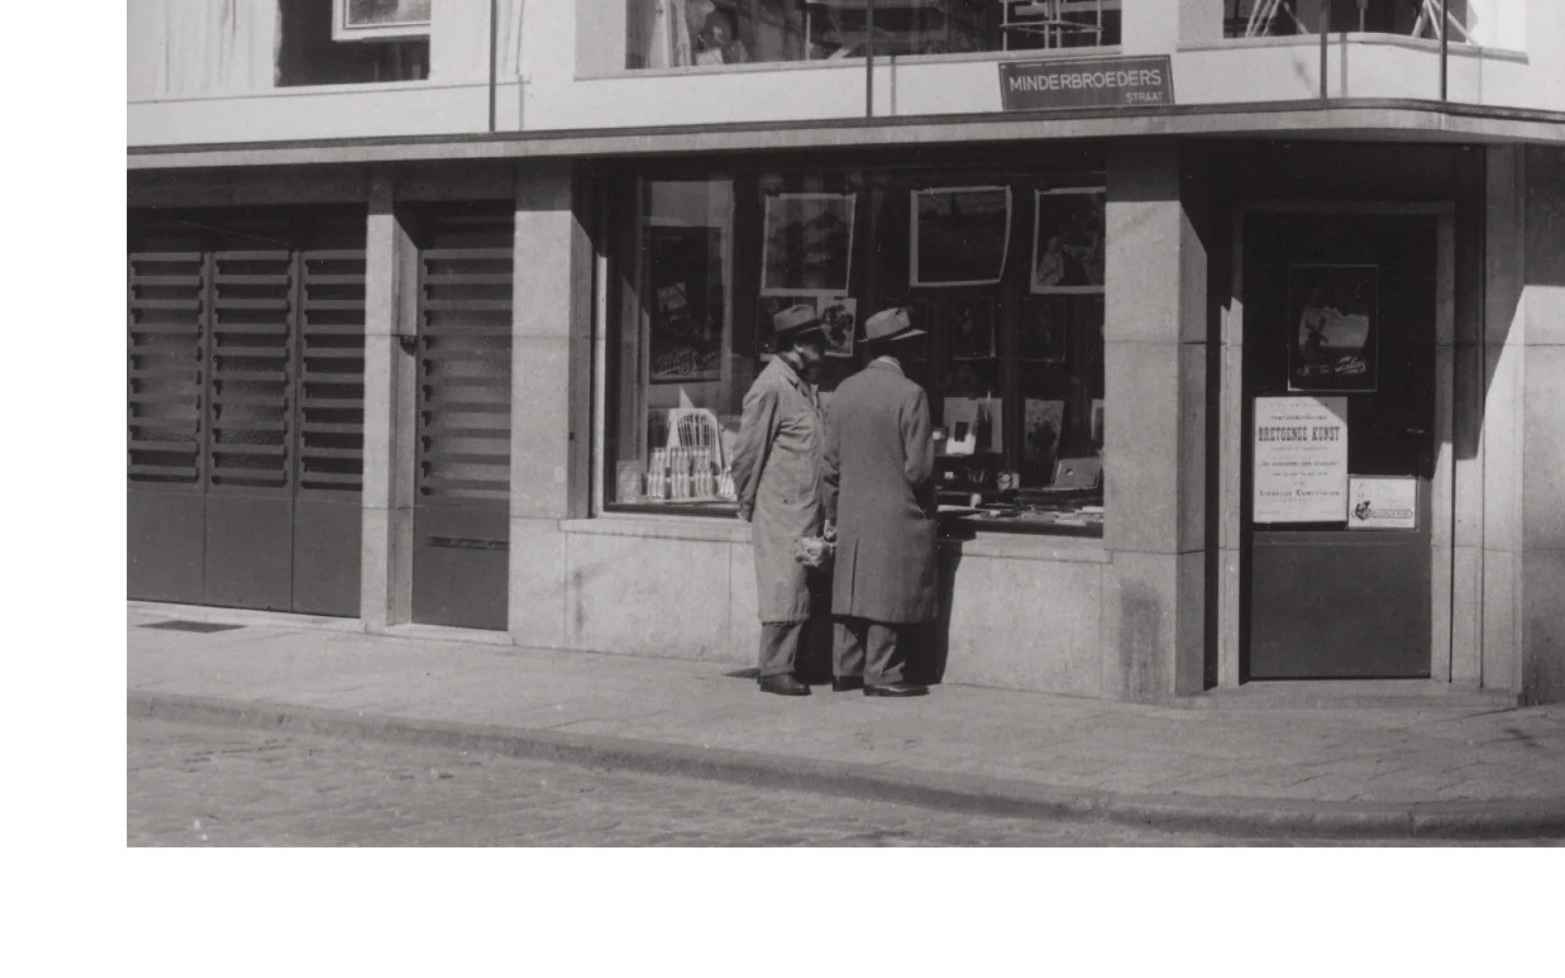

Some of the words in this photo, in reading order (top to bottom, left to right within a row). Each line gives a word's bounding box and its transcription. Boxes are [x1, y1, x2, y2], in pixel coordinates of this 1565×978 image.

[1009, 70, 1162, 92] MINDERBROEDERS
[1125, 91, 1163, 103] STRAAT
[1311, 426, 1341, 442] KUNST
